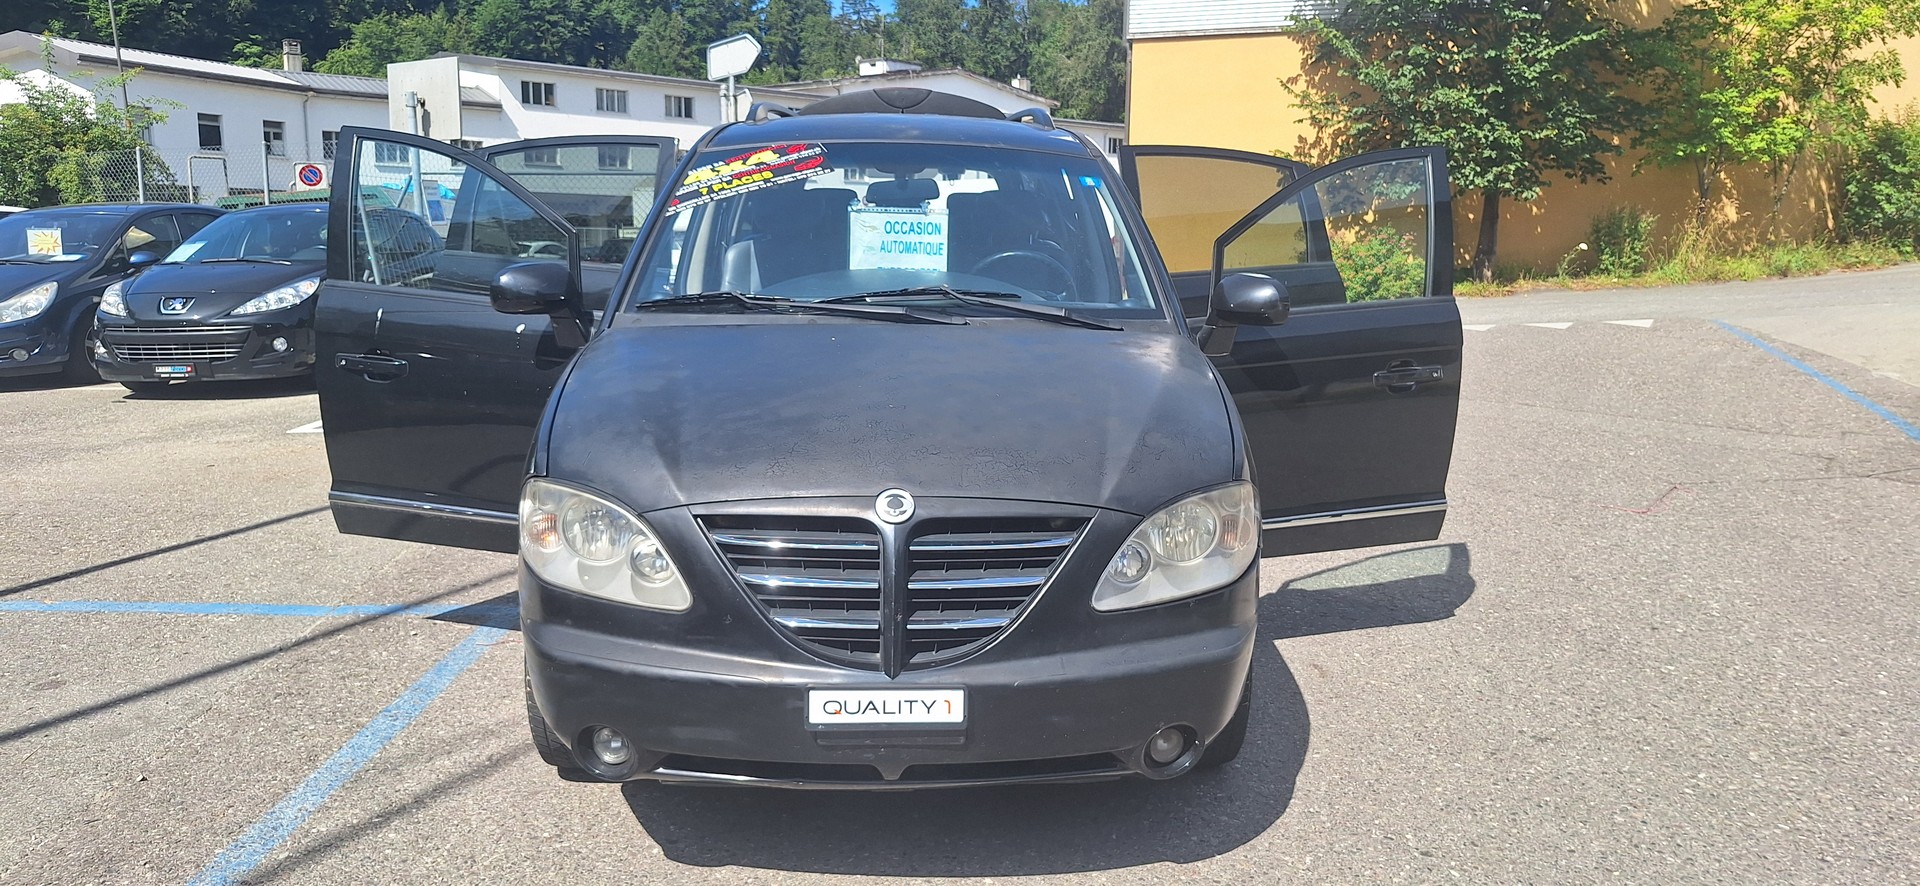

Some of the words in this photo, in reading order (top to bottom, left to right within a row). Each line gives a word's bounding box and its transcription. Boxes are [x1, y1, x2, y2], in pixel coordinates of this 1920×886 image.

[699, 187, 709, 196] 7
[711, 170, 774, 192] PLACES
[884, 220, 942, 236] OCCASION
[880, 240, 945, 256] AUTOMATIQUE
[823, 700, 937, 715] QUALITY
[944, 699, 951, 714] 1
